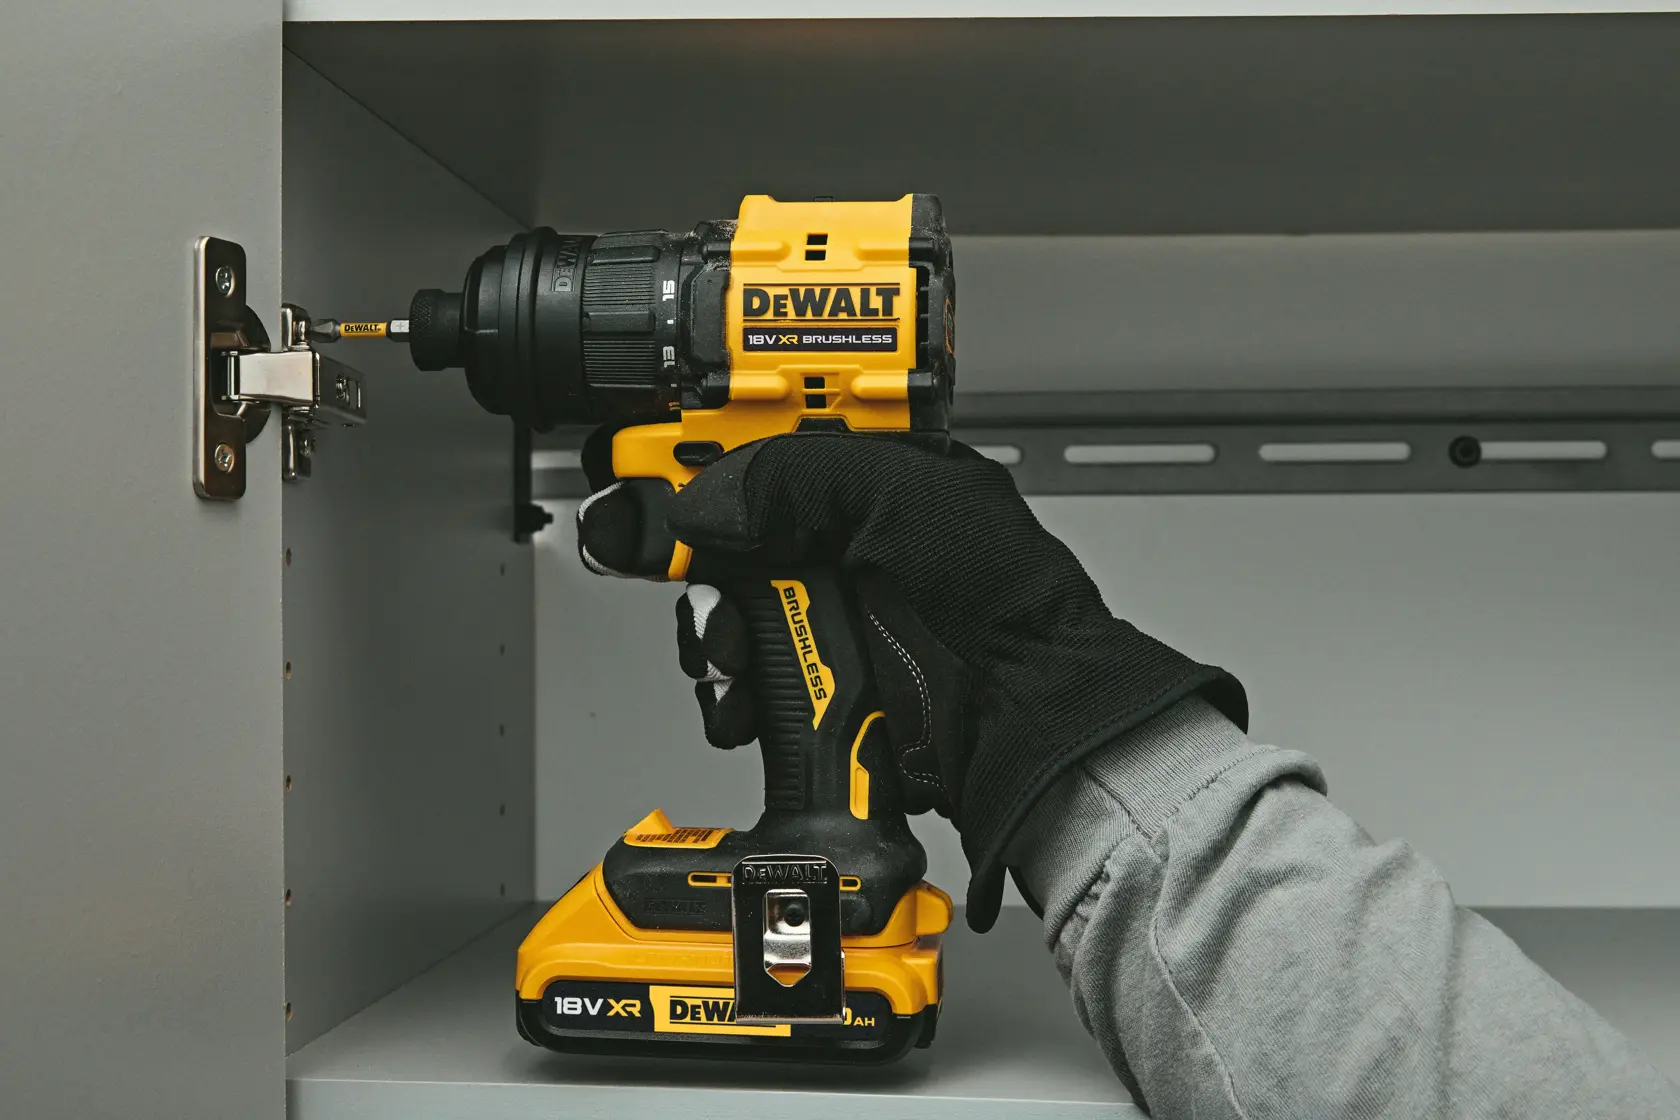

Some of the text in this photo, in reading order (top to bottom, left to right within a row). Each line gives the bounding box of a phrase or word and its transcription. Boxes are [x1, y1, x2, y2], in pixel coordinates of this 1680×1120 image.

[662, 280, 675, 301] 15
[743, 287, 900, 317] DEWALT
[748, 334, 893, 345] 18V XR BRUSHLESS
[662, 346, 675, 368] 13
[783, 586, 828, 701] BRUSHLESS
[554, 997, 603, 1016] 18V
[606, 998, 642, 1017] XR
[669, 999, 737, 1023] DEW
